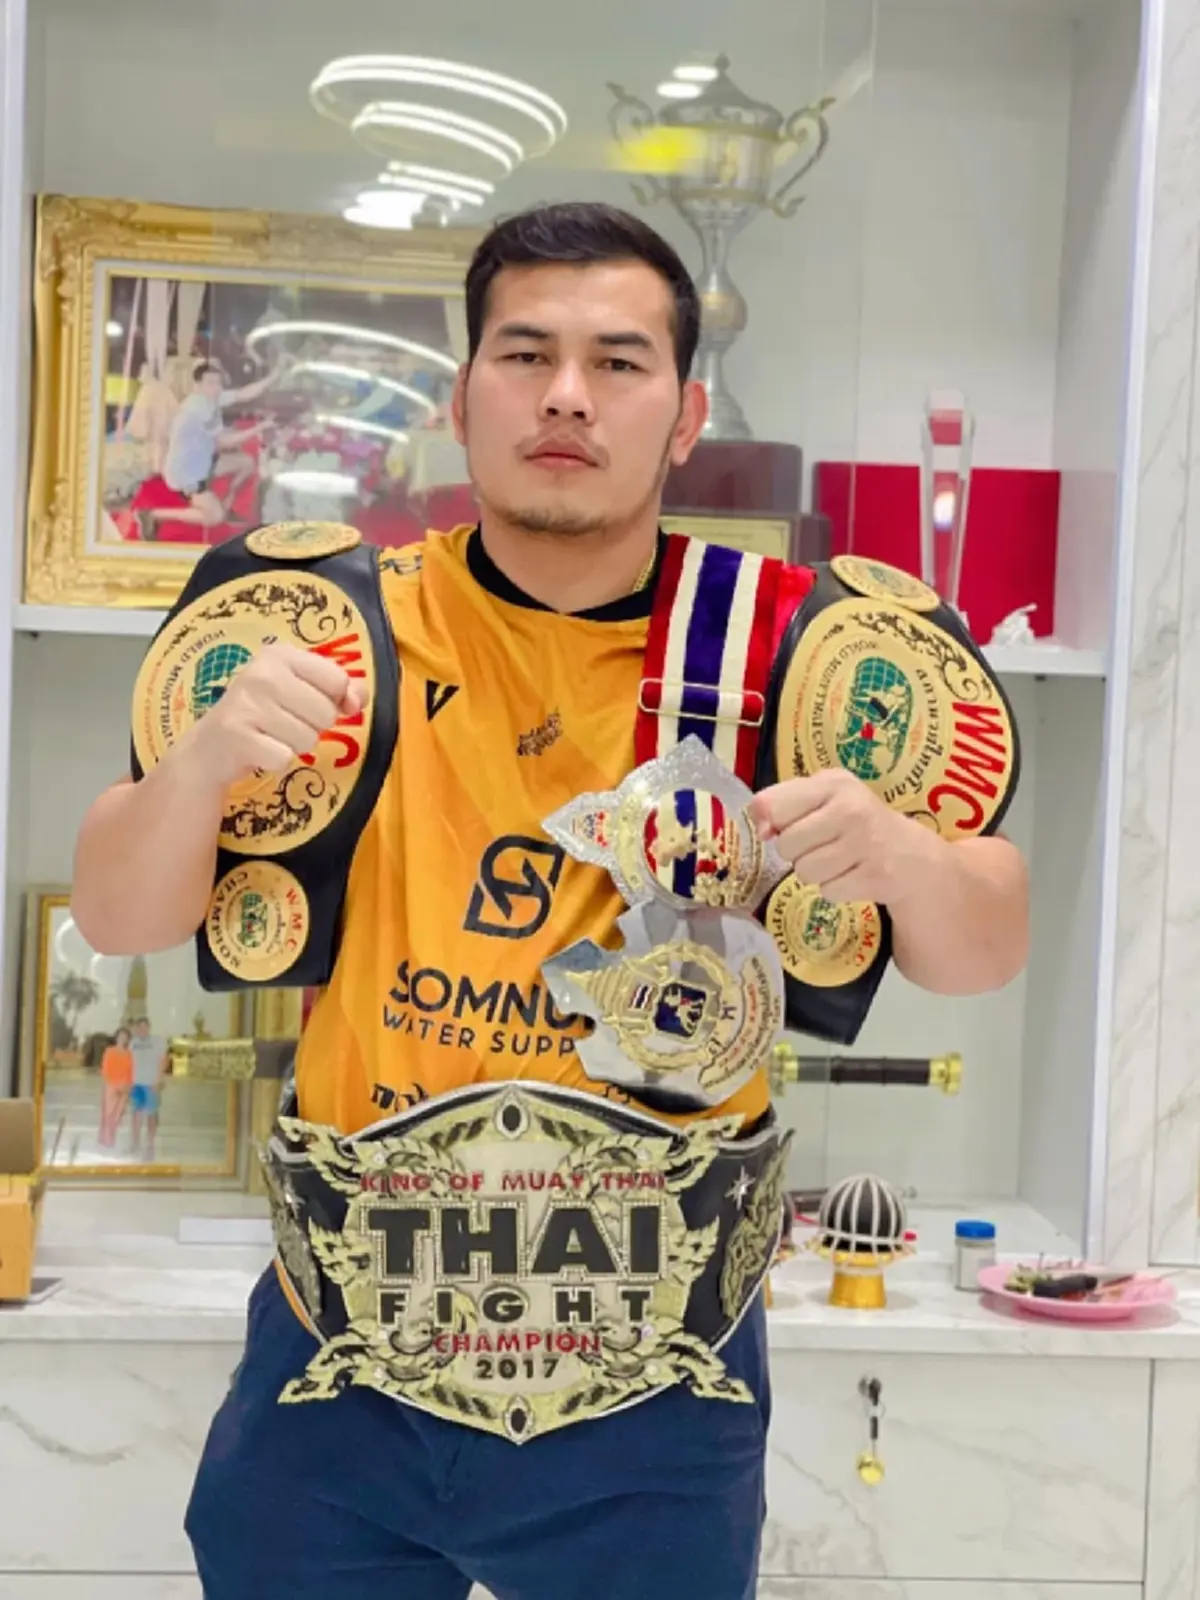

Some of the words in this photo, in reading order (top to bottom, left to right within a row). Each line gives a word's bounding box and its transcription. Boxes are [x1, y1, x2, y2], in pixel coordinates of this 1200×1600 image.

[927, 701, 1007, 831] WMC
[212, 871, 249, 969] CHAMPION
[771, 880, 802, 968] AMPION
[389, 959, 596, 1030] SOMNU
[490, 1030, 575, 1058] SUPP
[360, 1172, 431, 1193] KING
[449, 1172, 483, 1191] OF
[502, 1172, 585, 1191] MUAY
[601, 1172, 665, 1190] THAI
[366, 1205, 661, 1277] THAI
[379, 1290, 651, 1325] FIGHT
[433, 1333, 602, 1354] CHAMPION
[474, 1357, 561, 1380] 2017
